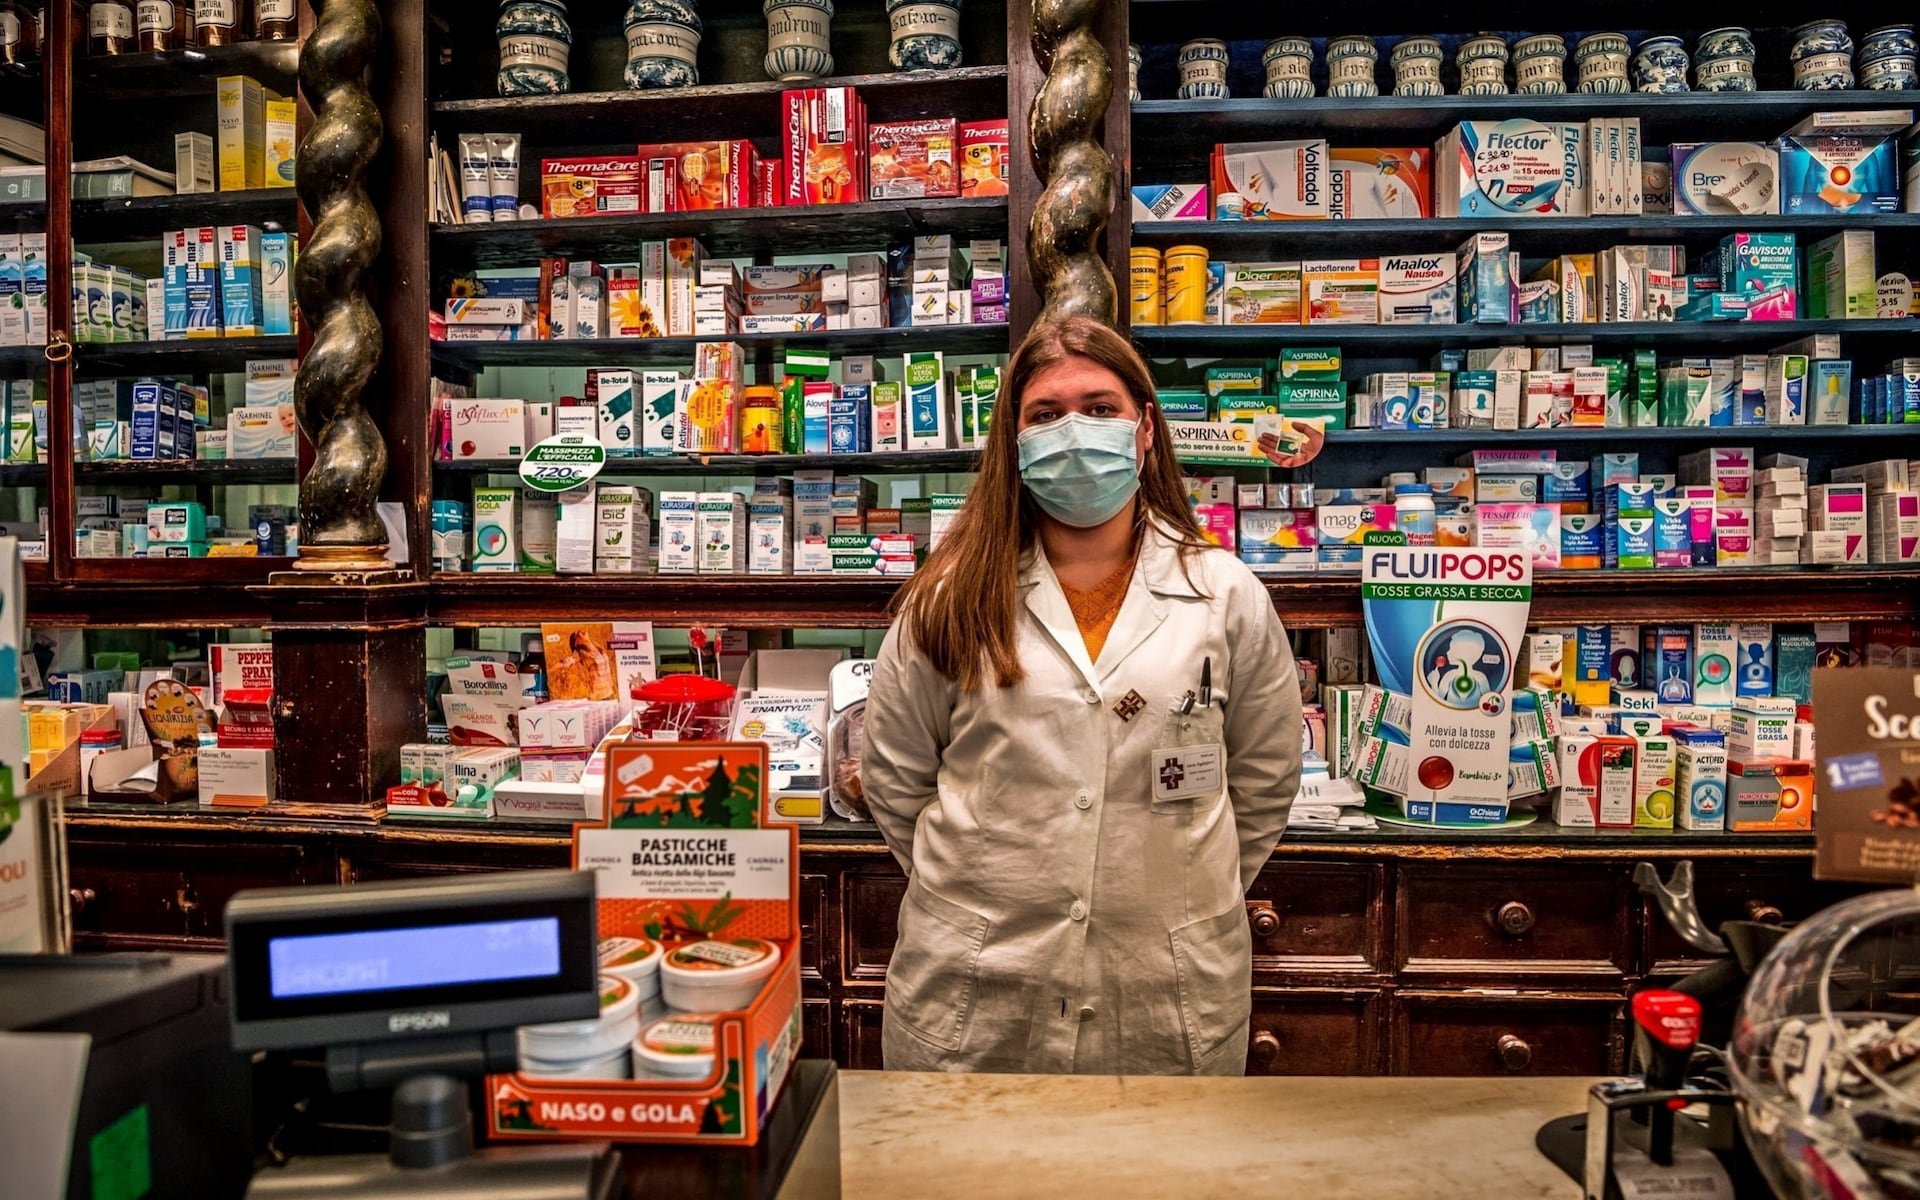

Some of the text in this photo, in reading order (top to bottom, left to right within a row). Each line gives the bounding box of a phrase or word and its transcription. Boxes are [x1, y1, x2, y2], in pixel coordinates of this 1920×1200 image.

[1487, 133, 1548, 150] Flector
[1610, 127, 1619, 160] Flector
[1628, 127, 1637, 160] Flector
[789, 97, 799, 200] ThermaCare
[1564, 127, 1579, 186] Flector
[547, 161, 640, 174] ThermaCare
[1305, 143, 1320, 206] Voltadol
[1150, 186, 1186, 220] BIOCHETASI
[1479, 235, 1508, 243] Maalox
[1739, 245, 1792, 255] GAVISCON
[1304, 264, 1355, 272] Lactoflorene
[1385, 257, 1443, 271] Maalox
[1404, 270, 1444, 279] Nausea
[751, 294, 776, 302] Voltaren
[1619, 280, 1628, 320] Maalox
[1292, 352, 1328, 360] ASPIRINA
[1329, 358, 1337, 366] C
[646, 376, 675, 384] Be-Total
[1217, 371, 1252, 379] ASPIRINA
[1289, 388, 1339, 398] ASPIRINA
[1229, 400, 1265, 408] ASPIRINA
[679, 412, 687, 448] Activdol
[1173, 427, 1244, 441] ASPIRINA C
[539, 447, 596, 455] MASSIMIZZA
[1214, 443, 1220, 451] è
[536, 453, 594, 461] L'EFFICACIA
[1478, 452, 1529, 460] TUSSIFLUID
[794, 485, 831, 494] CURASEPT
[476, 494, 511, 502] FROBEN
[599, 495, 631, 503] CURASEPT
[932, 498, 965, 506] DENTOSAN
[751, 505, 782, 513] CURASEPT
[1323, 514, 1356, 529] mag
[830, 537, 867, 545] DENTOSAN
[1369, 535, 1402, 543] NUOVO
[835, 557, 872, 565] DENTOSAN
[1371, 553, 1524, 581] FLUIPOPS
[1371, 585, 1522, 599] TOSSE GRASSA E SECCA
[241, 667, 272, 678] SPRAY
[464, 680, 508, 690] Borocillina
[1623, 697, 1654, 710] Seki
[1365, 692, 1383, 733] FLUIPOPS
[1539, 693, 1555, 735] FLUIPOPS
[1425, 725, 1495, 739] Allevia la tosse
[1429, 739, 1490, 750] con dolcezza
[1363, 740, 1380, 782] FLUIPOPS
[1539, 744, 1555, 786] FLUIPOPS
[455, 764, 476, 777] llina
[1459, 770, 1492, 780] Bambini
[1828, 762, 1845, 787] 1
[512, 799, 541, 811] Vagisil
[1411, 805, 1418, 815] 6
[641, 839, 727, 851] PASTICCHE
[632, 853, 736, 866] BALSAMICHE
[388, 1011, 450, 1032] EPSON
[540, 1103, 695, 1123] NASO e GOLA
